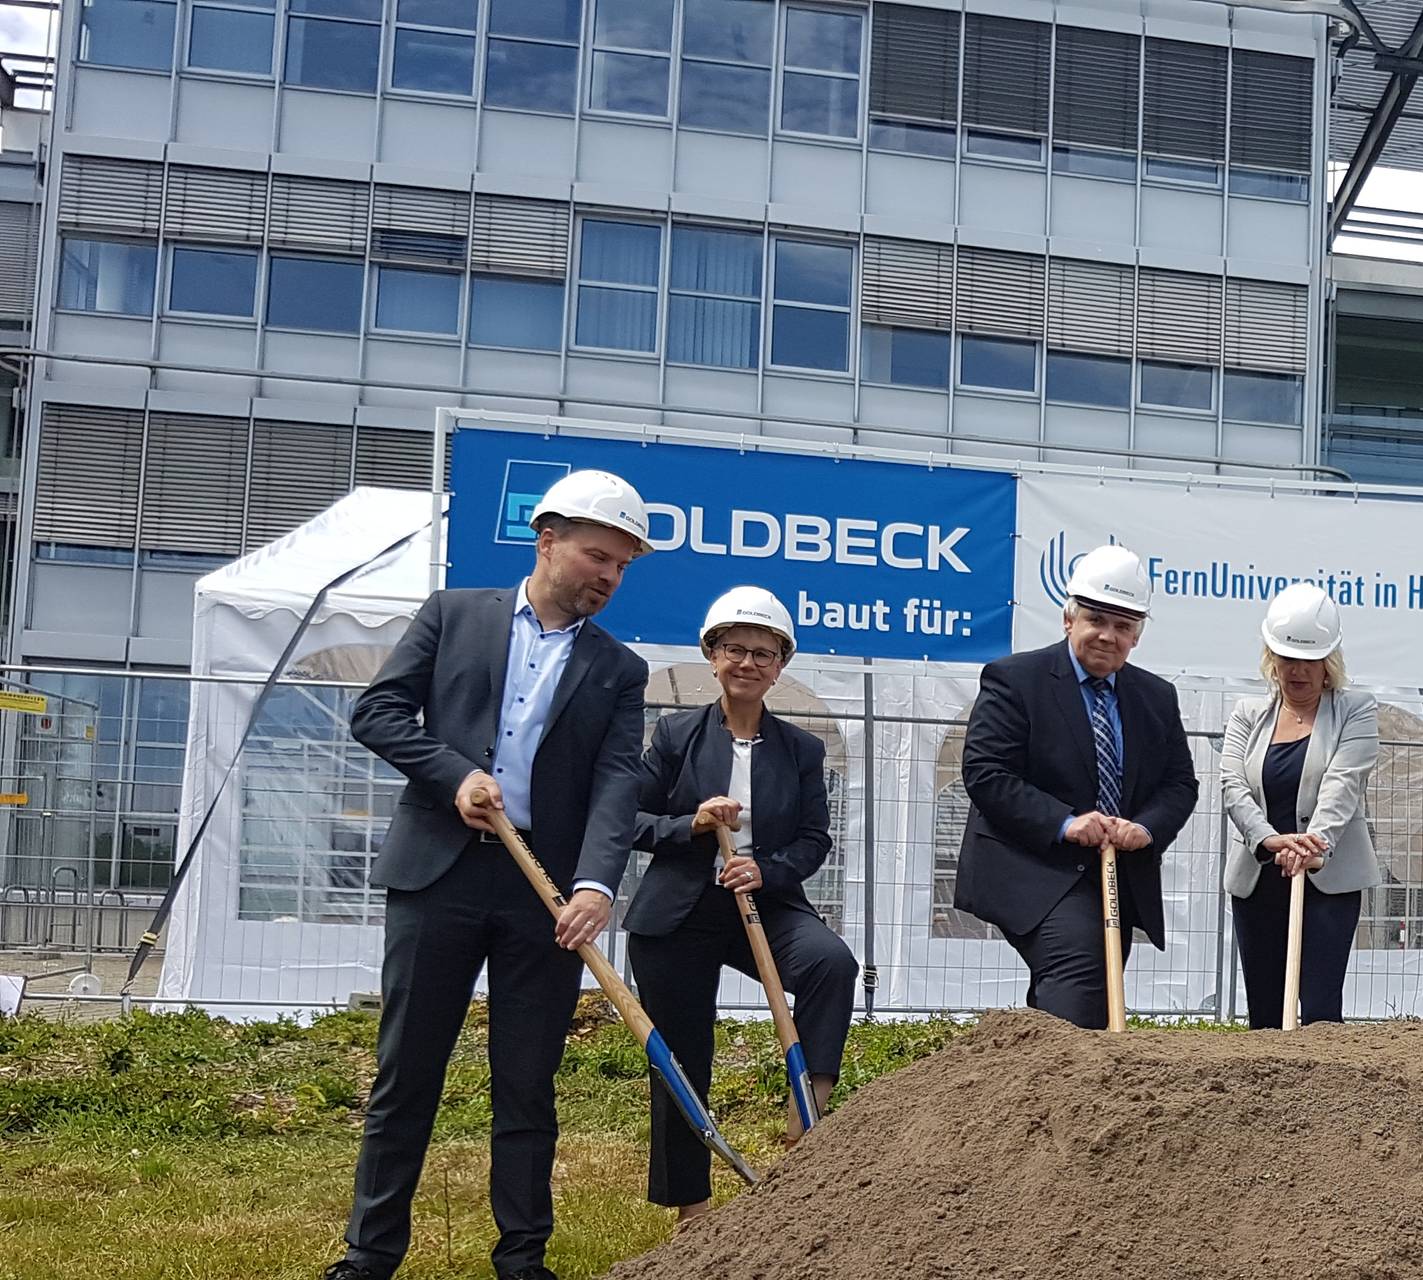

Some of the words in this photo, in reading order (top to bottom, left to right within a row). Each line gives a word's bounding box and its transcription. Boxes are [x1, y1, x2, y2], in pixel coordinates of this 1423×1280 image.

[645, 502, 972, 574] OLDBECK
[798, 591, 890, 631] baut
[904, 598, 971, 636] für:
[1375, 573, 1397, 608] in
[1106, 860, 1119, 917] GOLDBECK
